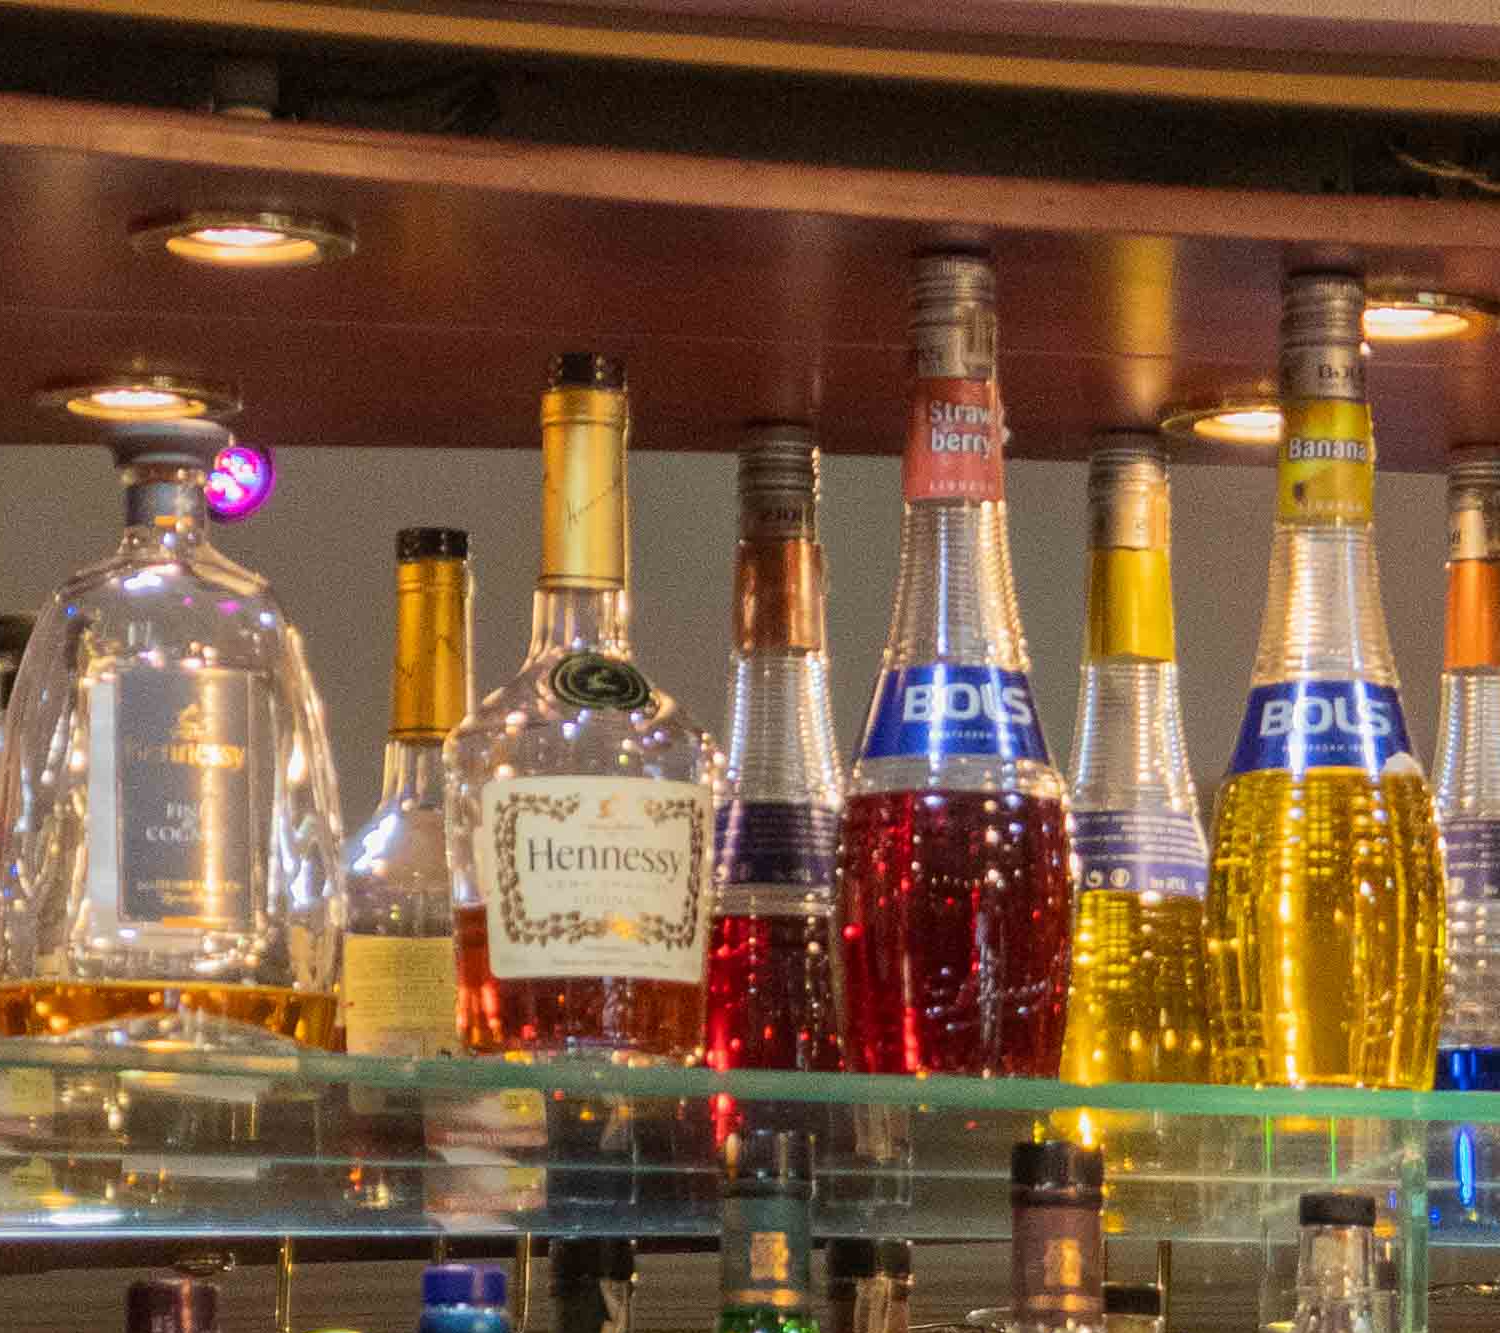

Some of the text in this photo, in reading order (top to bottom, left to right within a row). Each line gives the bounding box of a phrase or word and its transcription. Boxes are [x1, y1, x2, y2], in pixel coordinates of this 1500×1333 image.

[1288, 437, 1367, 462] Banana
[902, 682, 1031, 725] BOLS
[1260, 696, 1392, 738] BOLS
[528, 838, 683, 884] Hennessy
